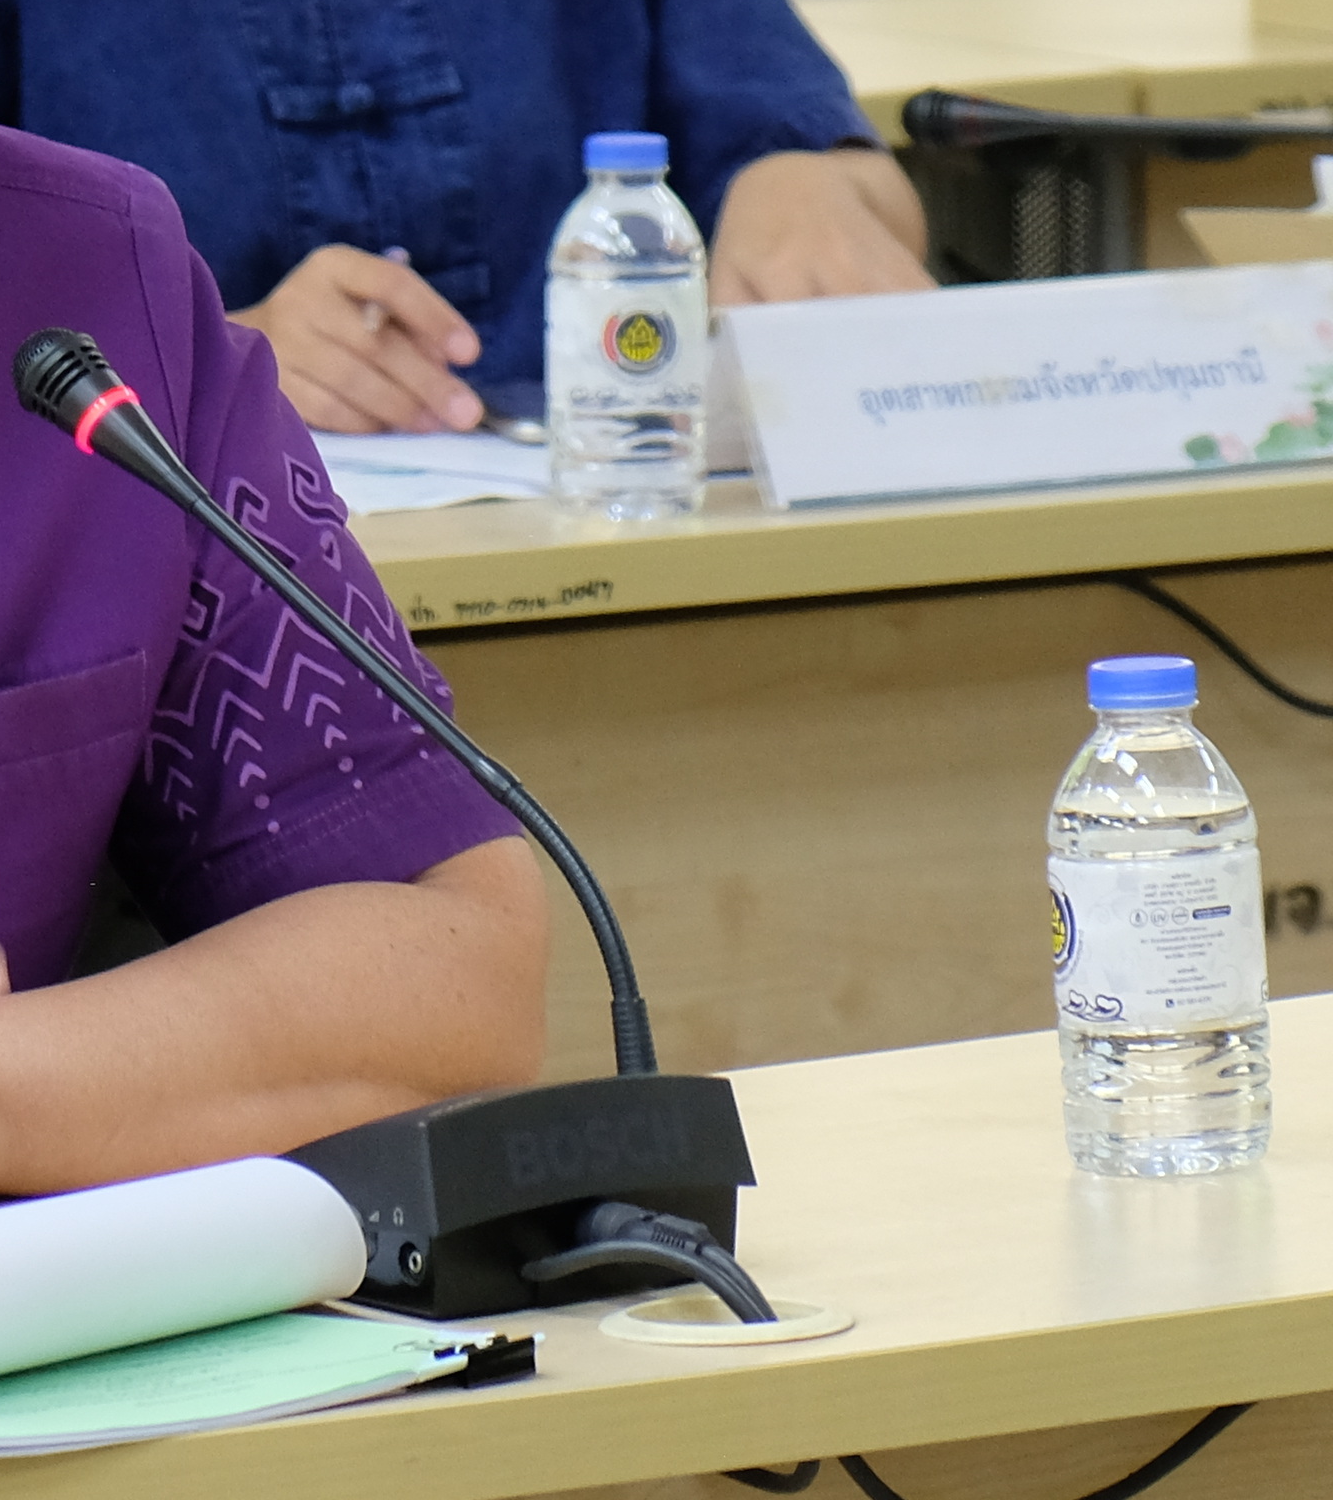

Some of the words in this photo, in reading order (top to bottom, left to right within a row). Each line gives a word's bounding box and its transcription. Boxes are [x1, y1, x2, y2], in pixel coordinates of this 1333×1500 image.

[856, 346, 1267, 425] อุตสาหกมจังหวัดปทุมธานี
